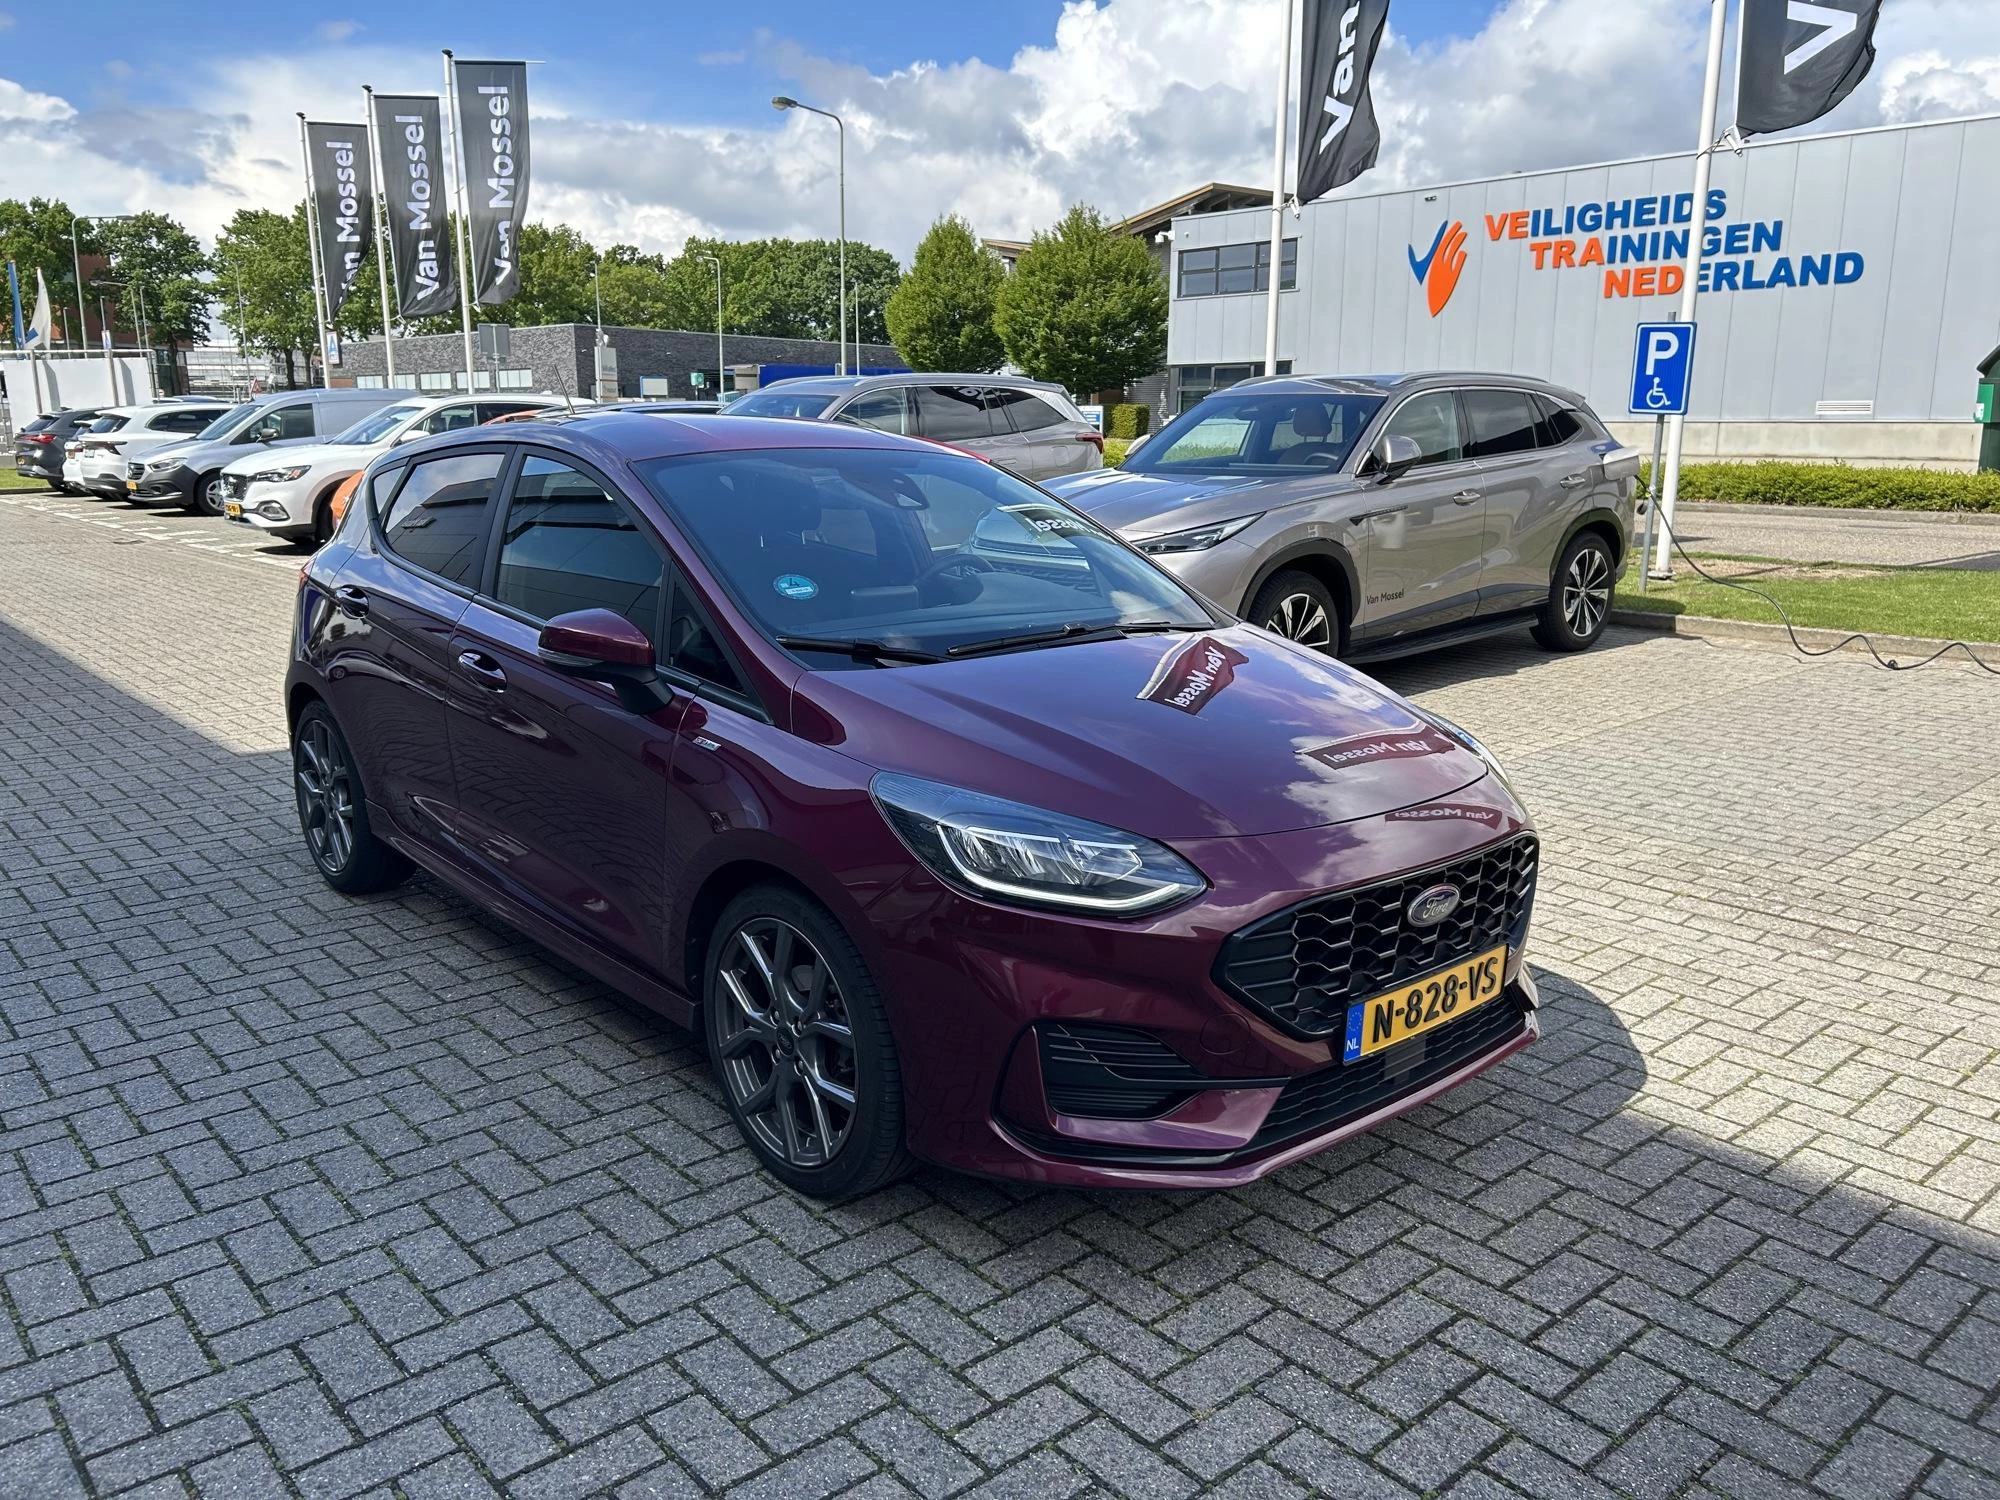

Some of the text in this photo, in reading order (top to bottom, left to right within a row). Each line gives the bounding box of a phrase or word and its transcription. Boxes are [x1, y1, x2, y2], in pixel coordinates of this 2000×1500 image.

[1319, 1, 1361, 155] Van
[326, 142, 360, 243] Mossel
[395, 115, 440, 300] Van Mossel
[478, 86, 515, 286] Van Mossel
[1485, 189, 1727, 241] VEILIGHEIDS
[1529, 220, 1784, 271] TRAININGEN
[1604, 251, 1864, 299] NEDERLAND
[1645, 331, 1679, 376] P
[1366, 588, 1404, 605] Van Mossel
[1422, 893, 1450, 920] Ford
[1372, 956, 1499, 1044] N-828-VS
[1346, 1038, 1360, 1052] NL
